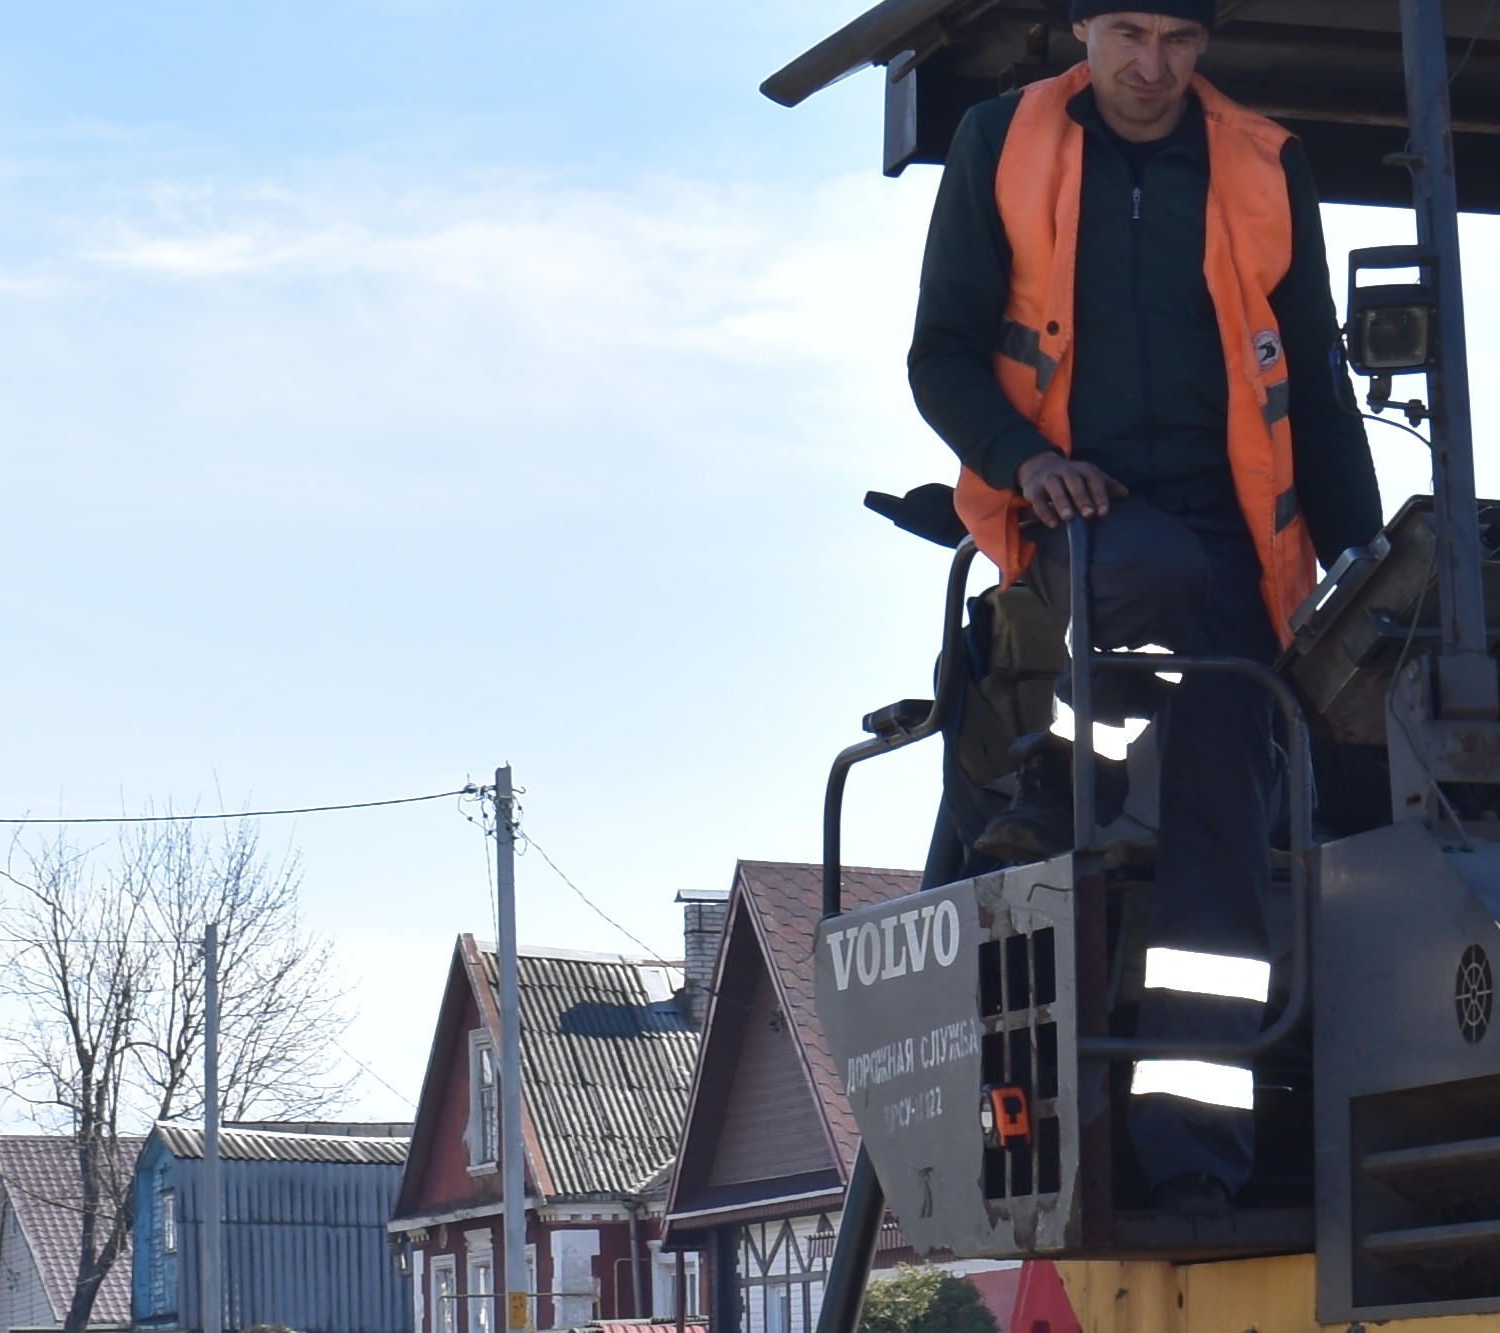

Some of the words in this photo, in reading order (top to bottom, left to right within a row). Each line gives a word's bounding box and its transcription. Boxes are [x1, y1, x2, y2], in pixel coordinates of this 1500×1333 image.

[827, 900, 960, 991] VOLVO
[846, 1037, 915, 1097] ДОРОЖНАЯ
[920, 1018, 979, 1070] СЛУЖБА
